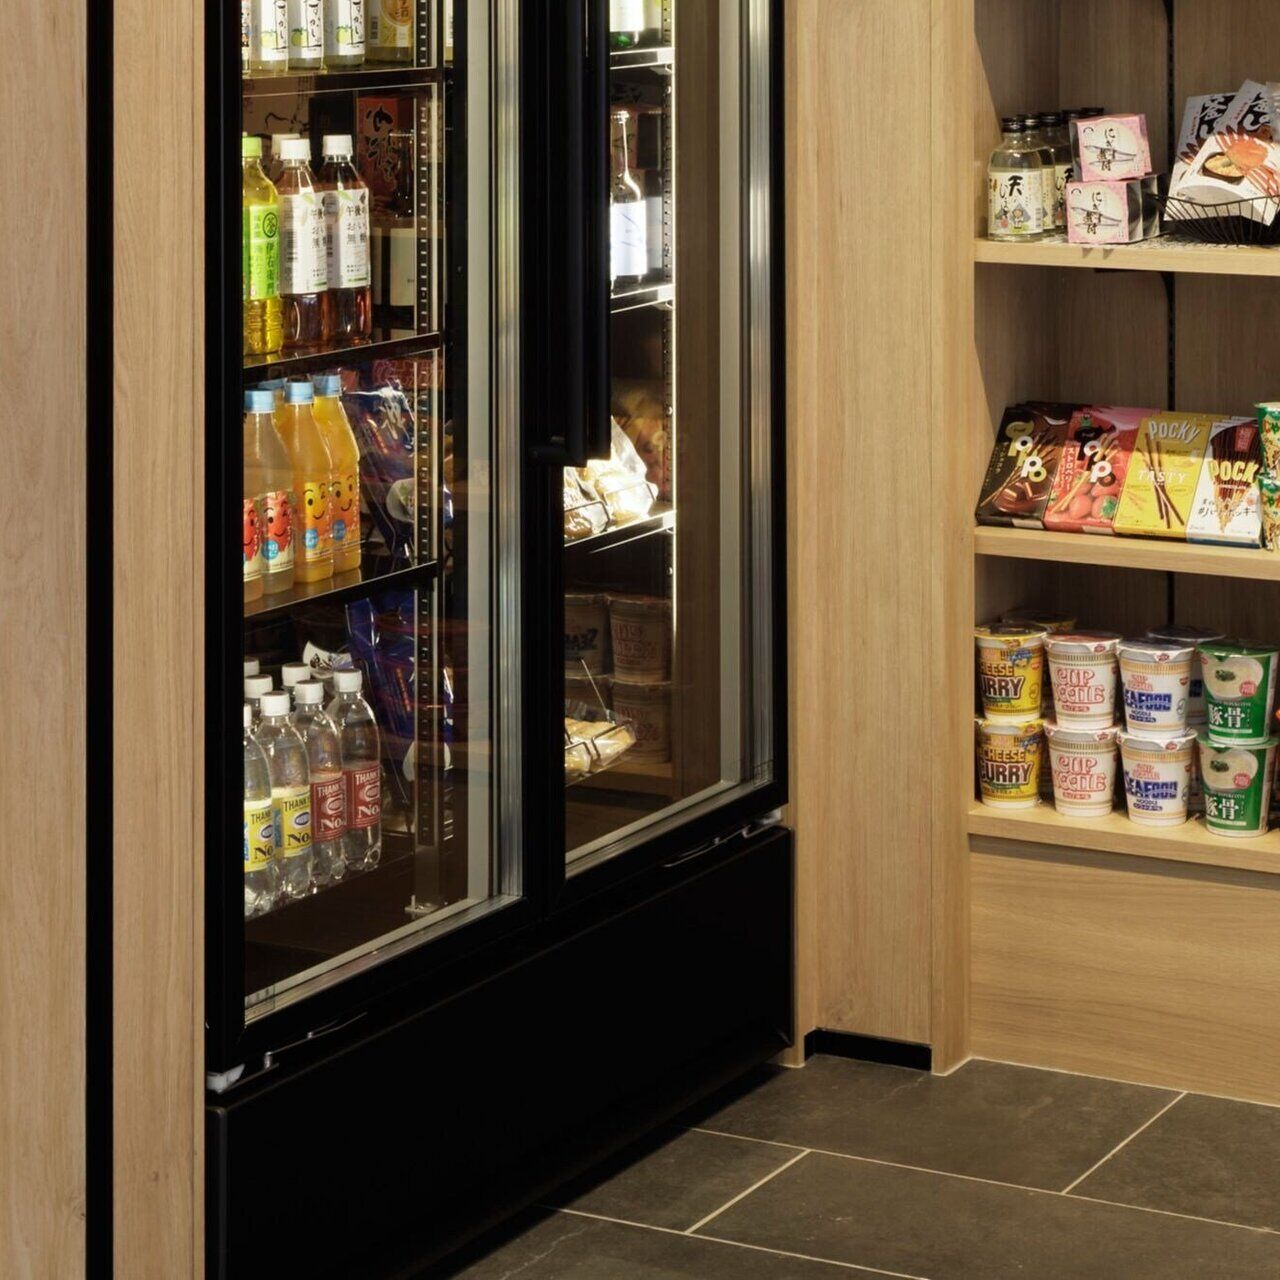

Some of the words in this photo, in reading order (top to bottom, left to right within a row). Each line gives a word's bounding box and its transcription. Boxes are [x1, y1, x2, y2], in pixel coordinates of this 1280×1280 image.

[1055, 667, 1096, 687] CUP
[1123, 690, 1173, 712] EAFOOD
[1057, 755, 1098, 774] CUP
